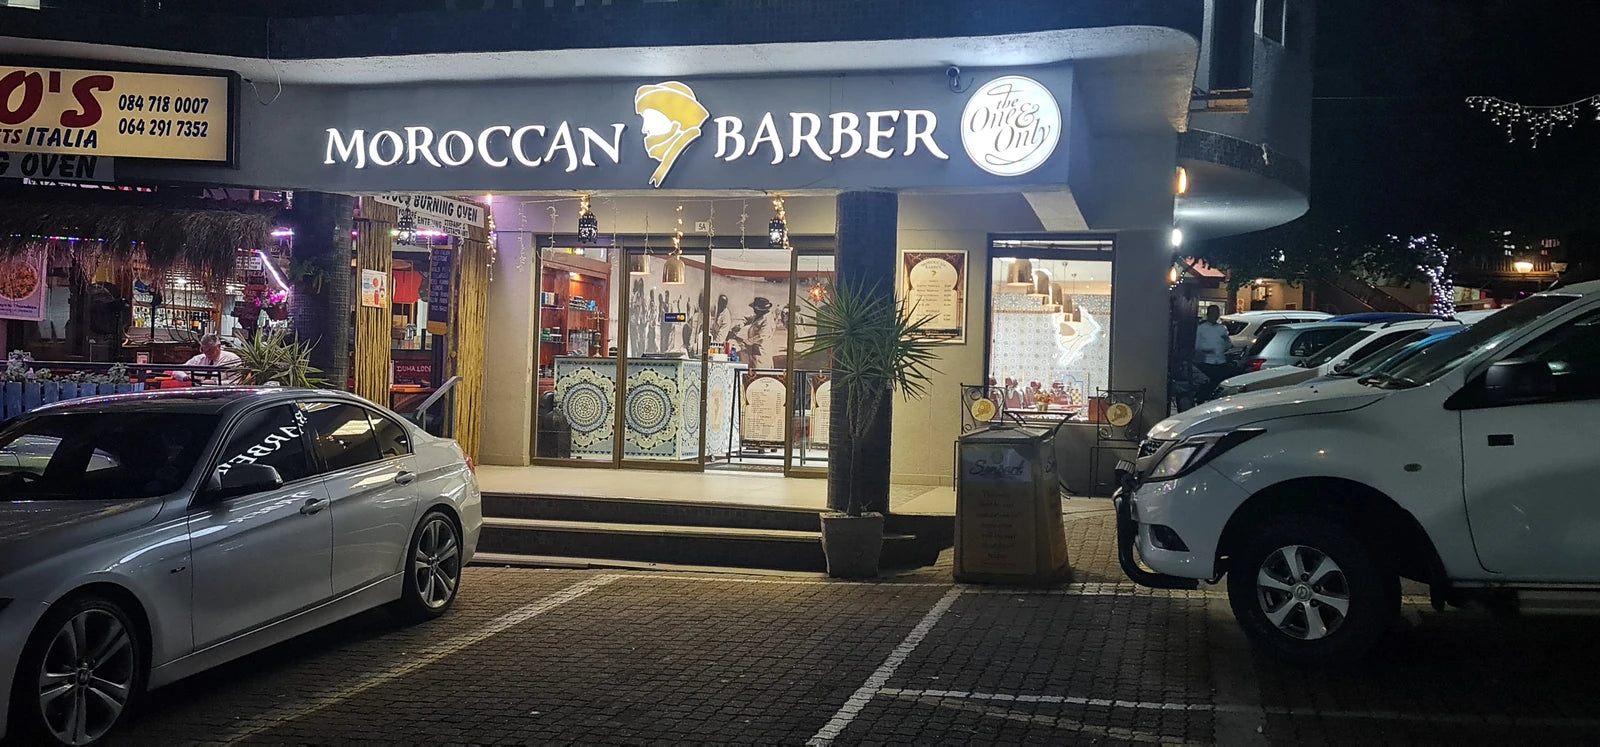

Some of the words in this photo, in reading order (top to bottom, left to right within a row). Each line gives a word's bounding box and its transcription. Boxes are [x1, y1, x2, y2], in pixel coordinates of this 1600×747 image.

[119, 94, 144, 112] 084
[149, 96, 171, 112] 718
[175, 97, 209, 114] 0007
[970, 106, 1017, 133] One
[1015, 102, 1040, 128] &
[0, 128, 22, 144] TS
[25, 126, 97, 148] ITALIA
[119, 118, 145, 135] 064
[149, 119, 172, 137] 291
[177, 121, 209, 137] 7352
[323, 120, 625, 172] MOROCCAN
[713, 109, 949, 165] BARBER
[985, 118, 1051, 166] Only
[21, 152, 97, 179] OVEN
[413, 195, 454, 217] BURNING
[457, 204, 478, 223] OVEN
